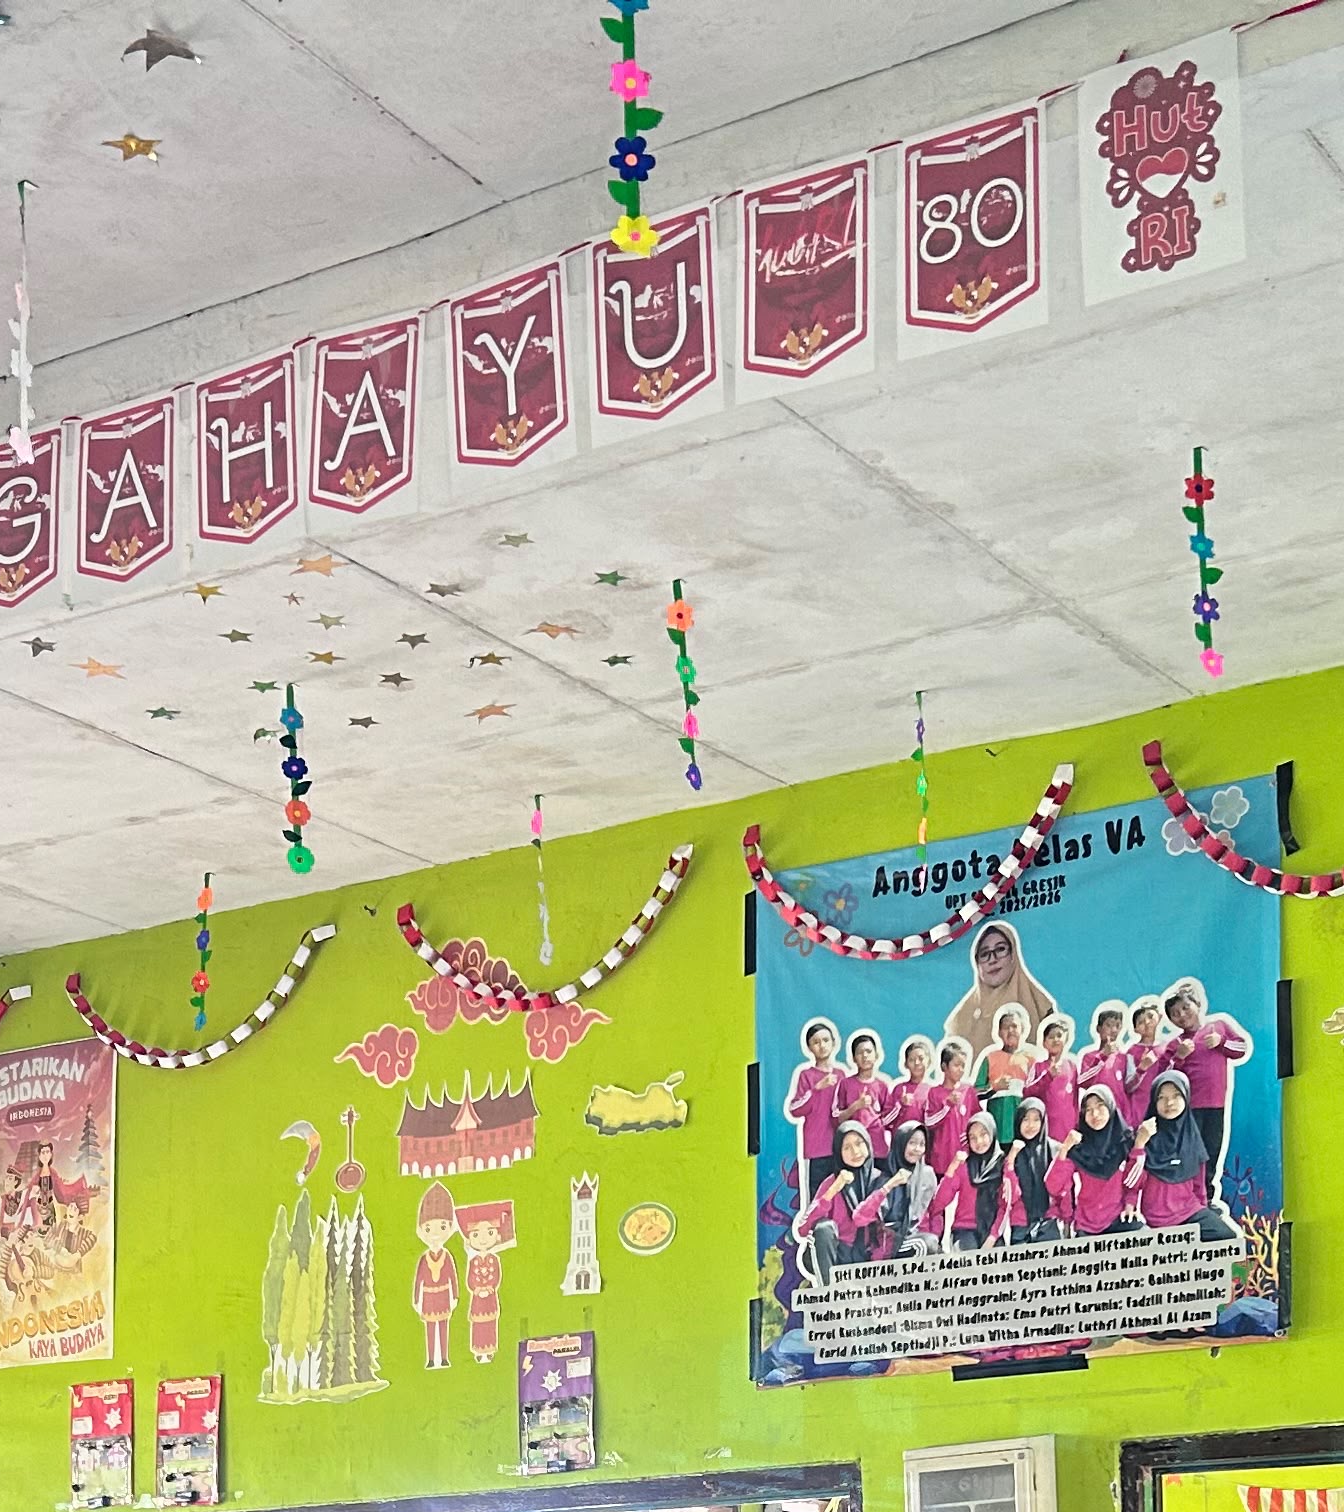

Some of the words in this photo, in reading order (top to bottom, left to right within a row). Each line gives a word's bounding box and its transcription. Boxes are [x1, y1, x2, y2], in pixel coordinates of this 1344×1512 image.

[1113, 92, 1209, 158] Hut
[920, 177, 1024, 265] 80
[1140, 206, 1192, 266] RI
[872, 850, 1000, 898] Anggota
[1105, 815, 1146, 855] VA
[1022, 875, 1066, 895] GRESIK
[9, 1107, 53, 1122] INDONESIA
[1053, 1242, 1090, 1257] Ahmad
[28, 1338, 57, 1359] KAYA
[59, 1322, 105, 1357] BUDAYA
